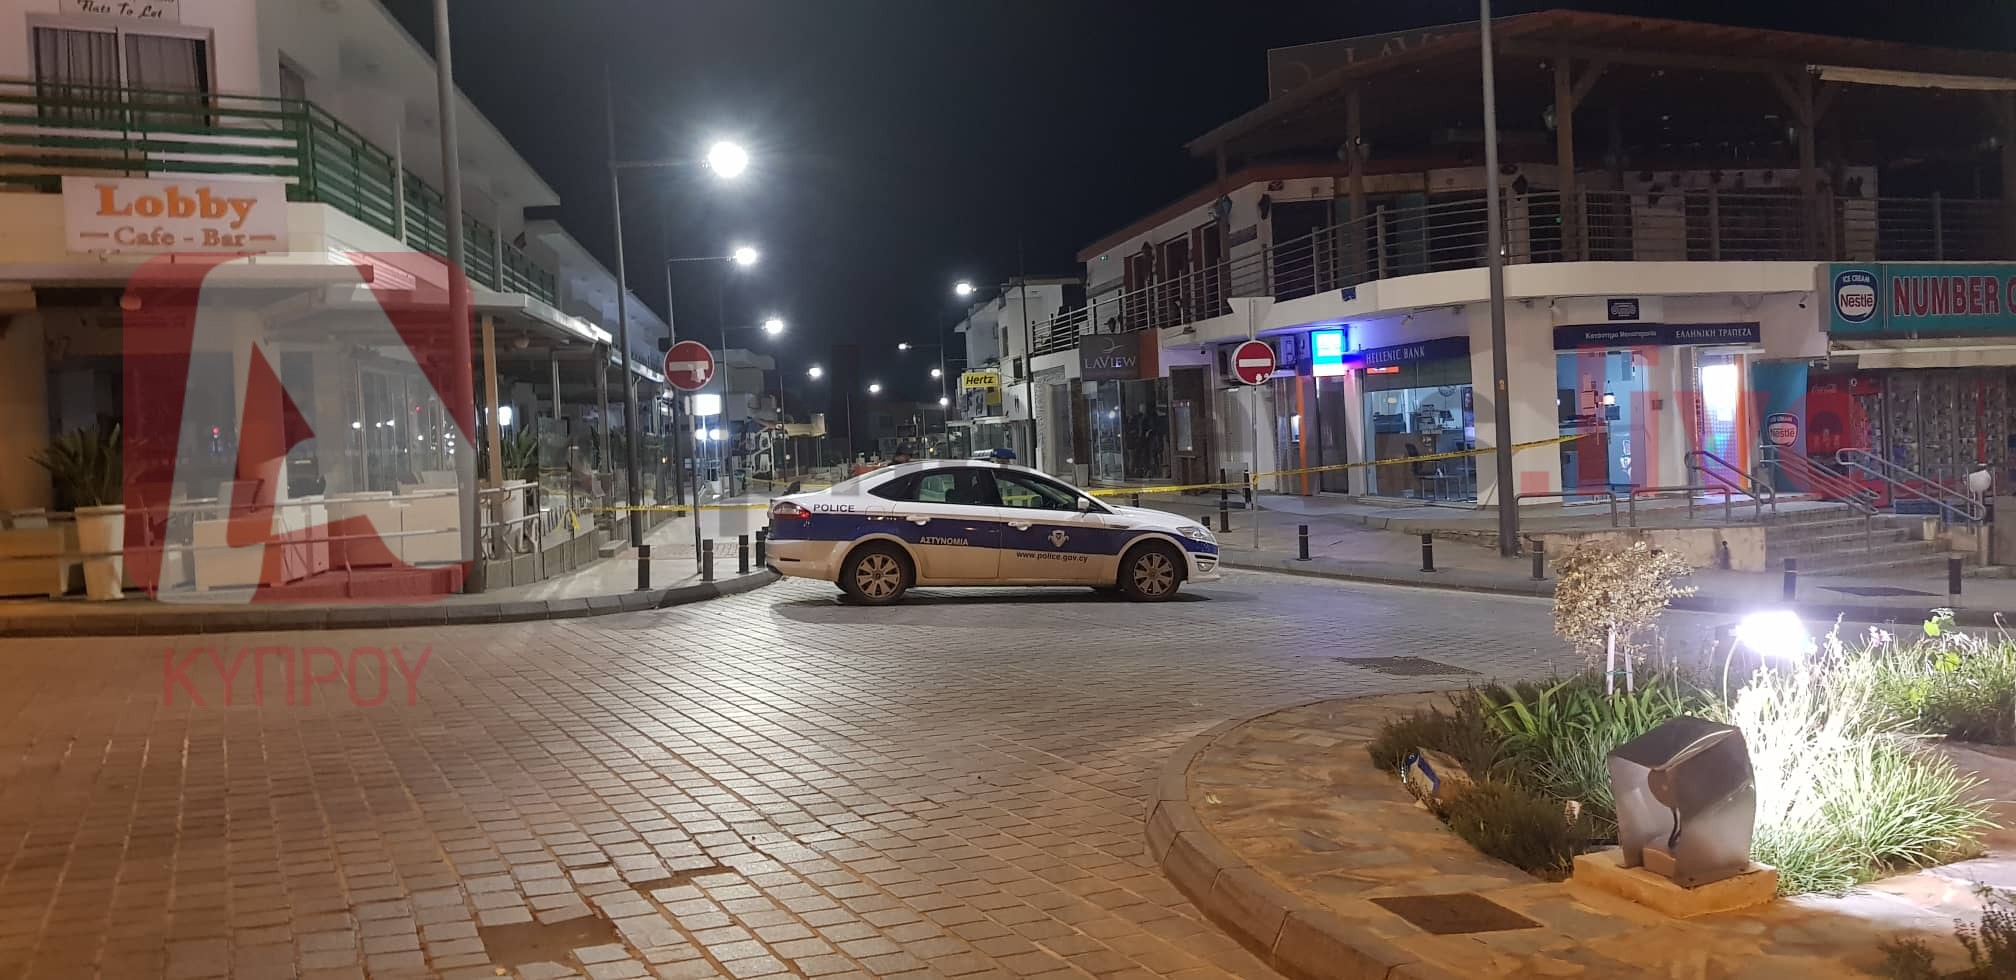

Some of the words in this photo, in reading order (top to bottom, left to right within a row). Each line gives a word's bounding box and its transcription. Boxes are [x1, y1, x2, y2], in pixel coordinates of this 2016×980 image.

[117, 2, 134, 16] To
[95, 184, 257, 230] Lobby
[114, 226, 175, 246] Cafe
[202, 228, 246, 247] Bar
[1893, 276, 2001, 317] NUMBER
[1675, 328, 1716, 338] ΕΛΛΗΝΙΚΗ
[1718, 327, 1752, 337] ΤΡΑΠΕΖΑ
[1366, 348, 1401, 365] HELLENIC
[1403, 345, 1425, 360] BANK
[966, 375, 994, 385] Hertz
[813, 503, 856, 513] POLICE
[919, 536, 969, 547] ΑΣΤΥΝΟΜΙΑ
